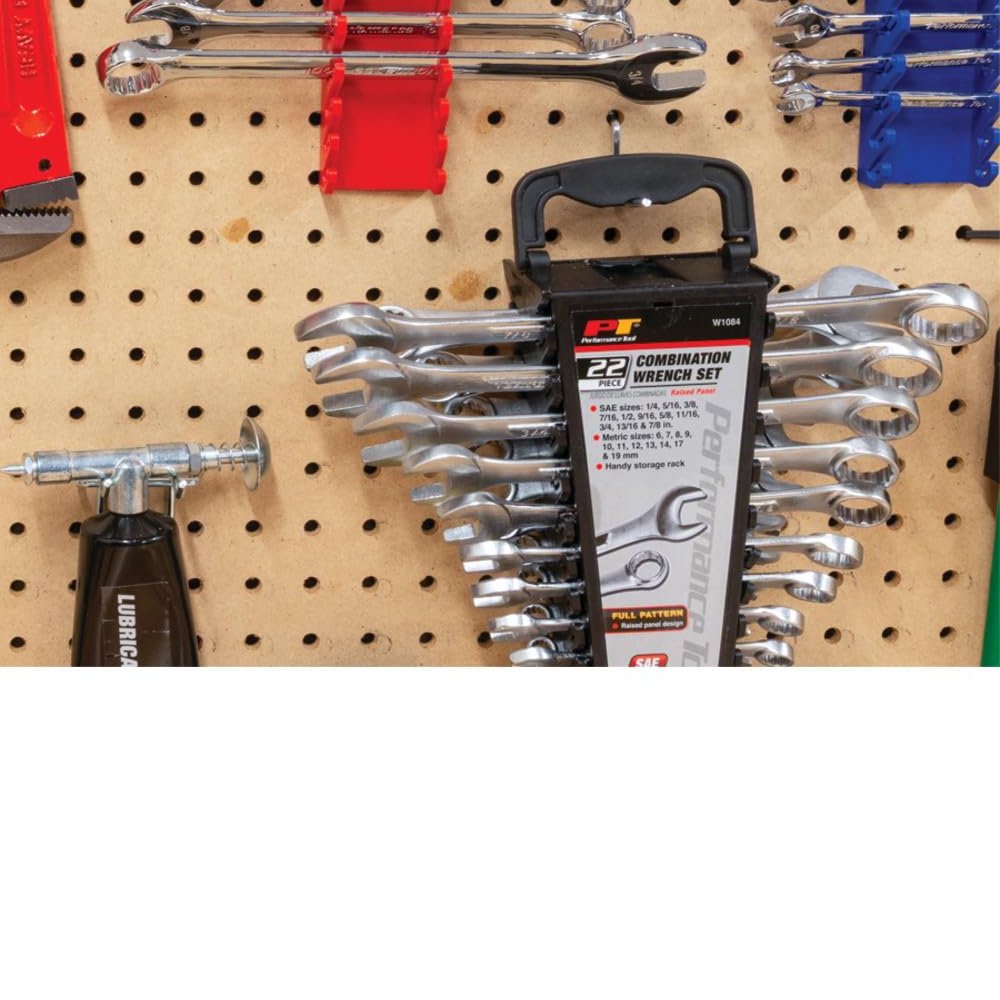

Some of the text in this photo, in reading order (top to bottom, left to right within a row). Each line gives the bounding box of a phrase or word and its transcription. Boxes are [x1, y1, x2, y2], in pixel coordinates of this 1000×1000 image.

[583, 318, 641, 336] PT
[712, 318, 741, 327] W1084
[636, 351, 731, 367] COMBINATION
[586, 358, 626, 377] 22
[633, 367, 722, 383] WRENCH SET
[600, 404, 617, 412] SAE
[646, 402, 660, 410] 1/4,
[662, 401, 682, 409] 5/16,
[600, 410, 700, 422] 7/16, 1/2, 9/16, 5/8, 11/16,
[600, 423, 614, 431] 3/4,
[617, 422, 639, 430] 13/16
[649, 421, 661, 429] 7/8
[602, 433, 628, 441] Metric
[656, 431, 664, 439] 6,
[665, 431, 673, 439] 7,
[684, 430, 692, 438] 9,
[602, 443, 614, 451] 10,
[631, 442, 643, 450] 12,
[645, 441, 658, 449] 13,
[605, 463, 632, 471] Handy
[634, 461, 665, 469] storage
[612, 609, 684, 620] FULL PATTERN
[644, 621, 661, 629] panel
[662, 620, 684, 628] design
[118, 594, 138, 667] LUBRICA
[635, 657, 661, 667] SAE
